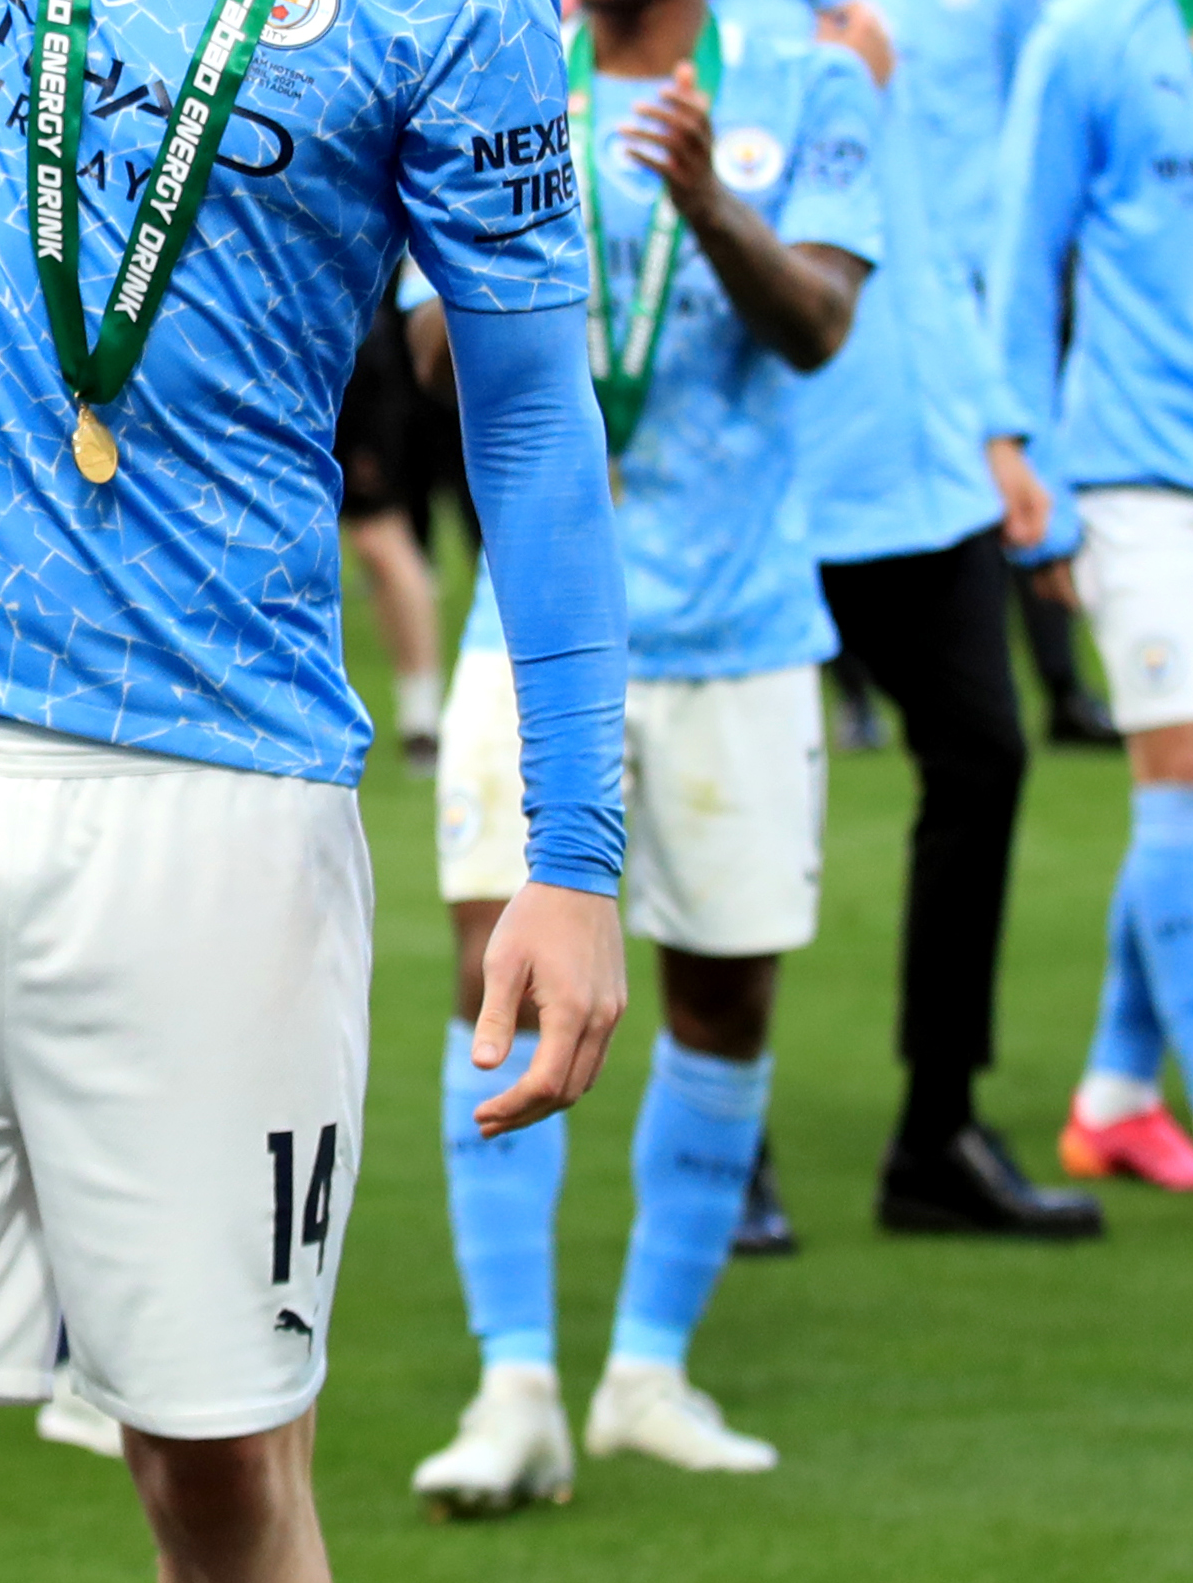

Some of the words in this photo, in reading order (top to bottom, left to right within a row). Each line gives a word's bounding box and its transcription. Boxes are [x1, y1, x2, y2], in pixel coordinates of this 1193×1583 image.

[37, 31, 70, 159] ENERGY
[37, 164, 63, 263] DRINK
[150, 96, 211, 226] ENERGY
[502, 161, 574, 216] TIRE
[114, 222, 167, 323] DRINK
[267, 1123, 337, 1285] 14
